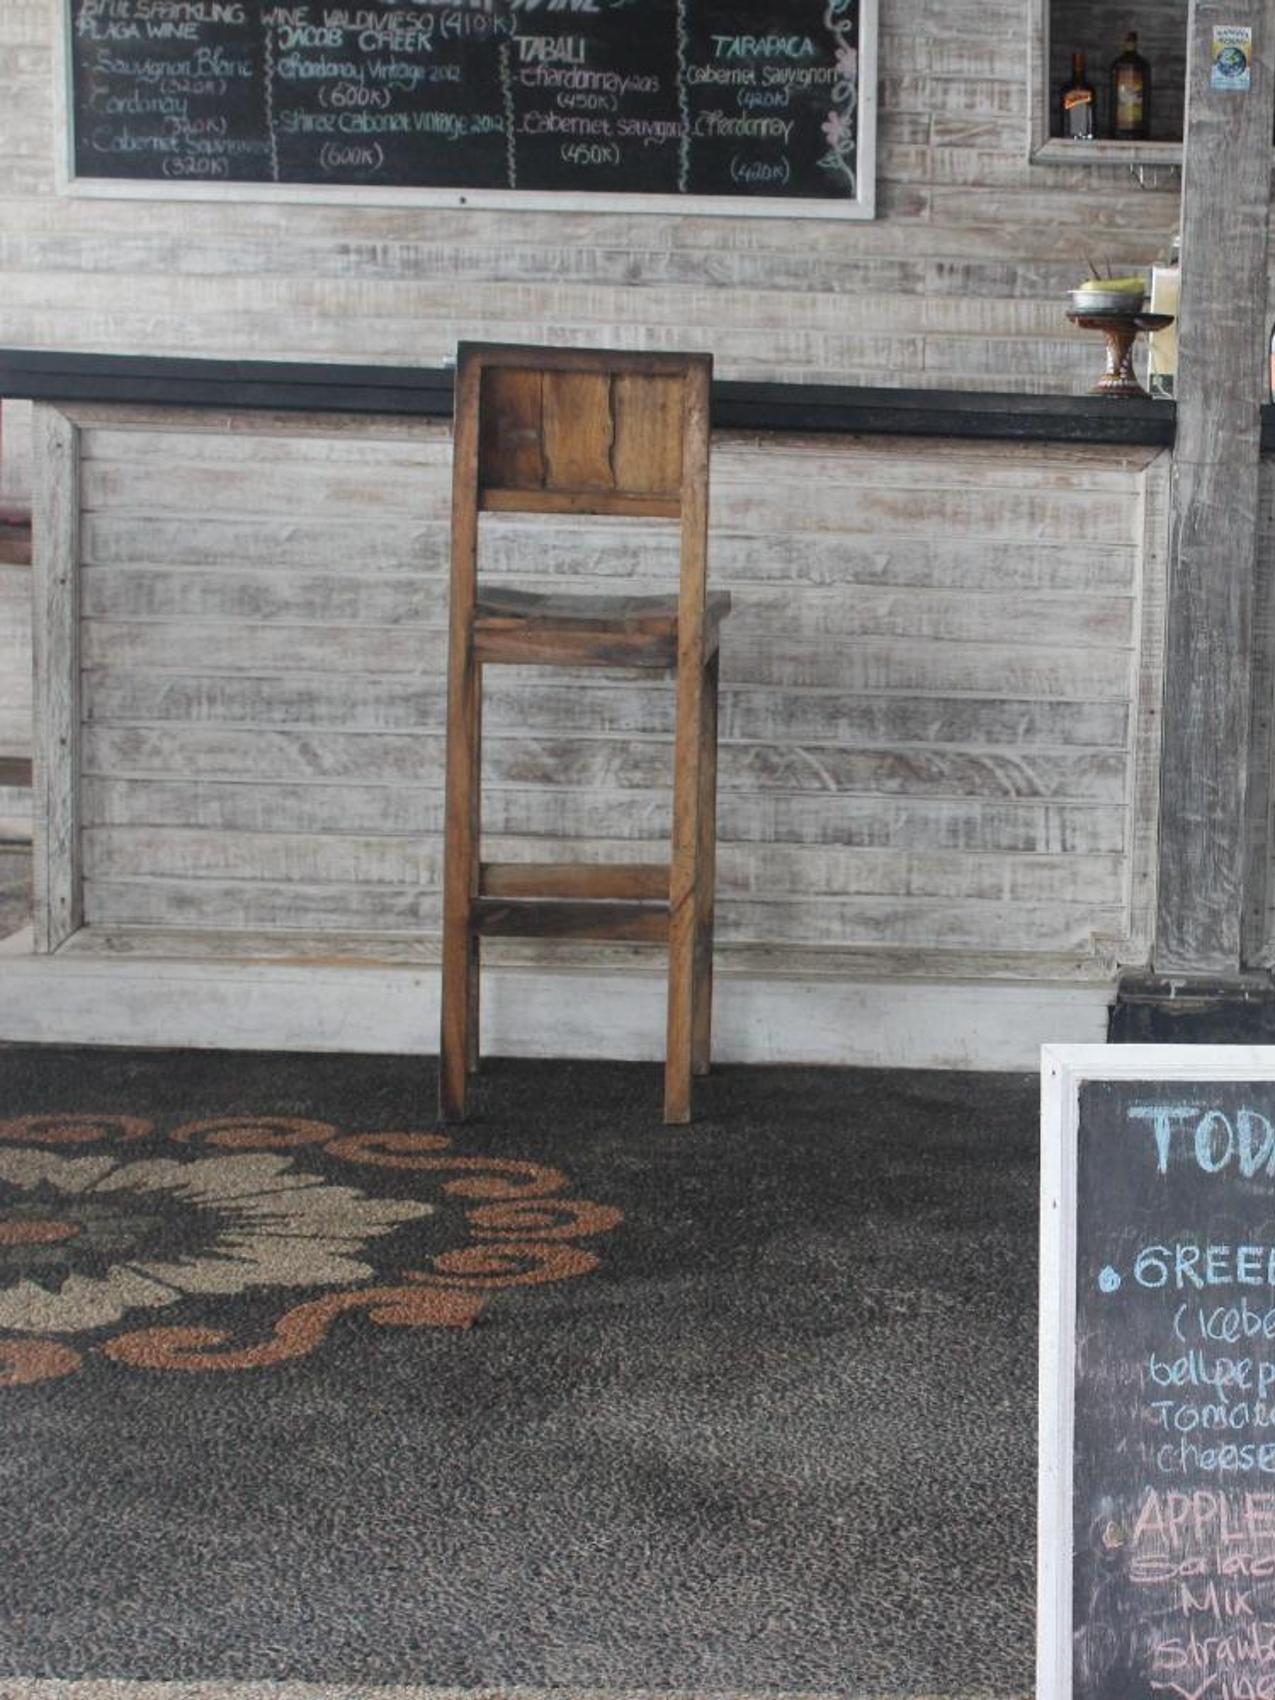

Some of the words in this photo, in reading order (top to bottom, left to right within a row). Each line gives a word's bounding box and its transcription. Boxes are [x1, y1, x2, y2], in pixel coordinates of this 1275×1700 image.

[260, 6, 309, 27] WINE
[78, 18, 140, 39] PLAGA
[146, 21, 200, 39] WINE
[277, 27, 344, 49] JACOB
[512, 35, 586, 64] TABALI
[193, 47, 254, 77] Blanc
